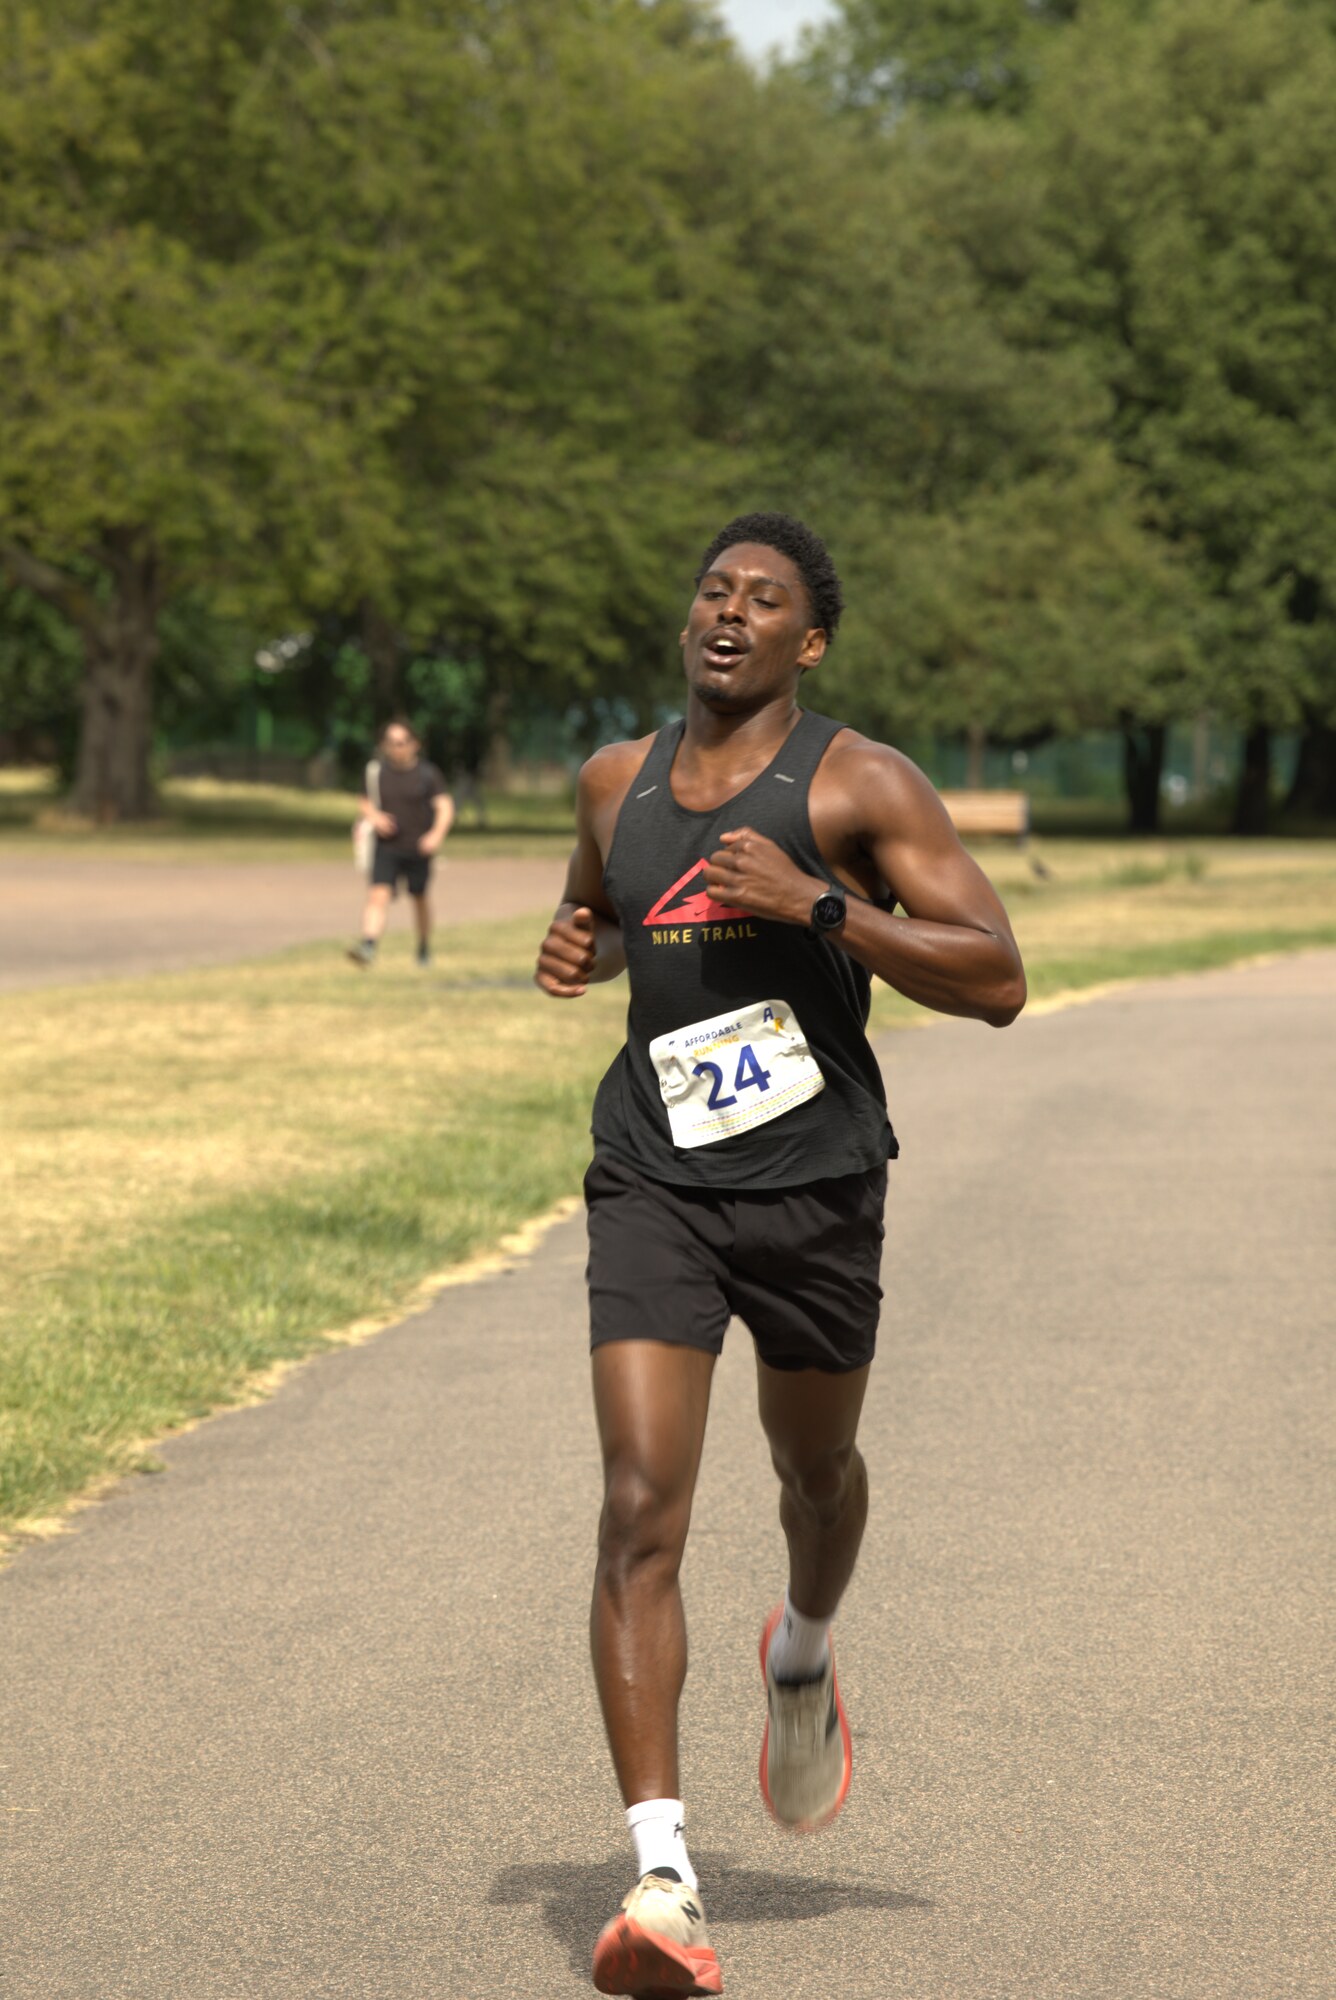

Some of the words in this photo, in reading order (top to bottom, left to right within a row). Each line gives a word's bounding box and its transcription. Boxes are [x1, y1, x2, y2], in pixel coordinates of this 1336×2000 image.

[652, 928, 693, 945] NIKE
[701, 924, 758, 942] TRAIL
[684, 1021, 744, 1048] AFFORDABLE
[692, 1044, 772, 1111] 24
